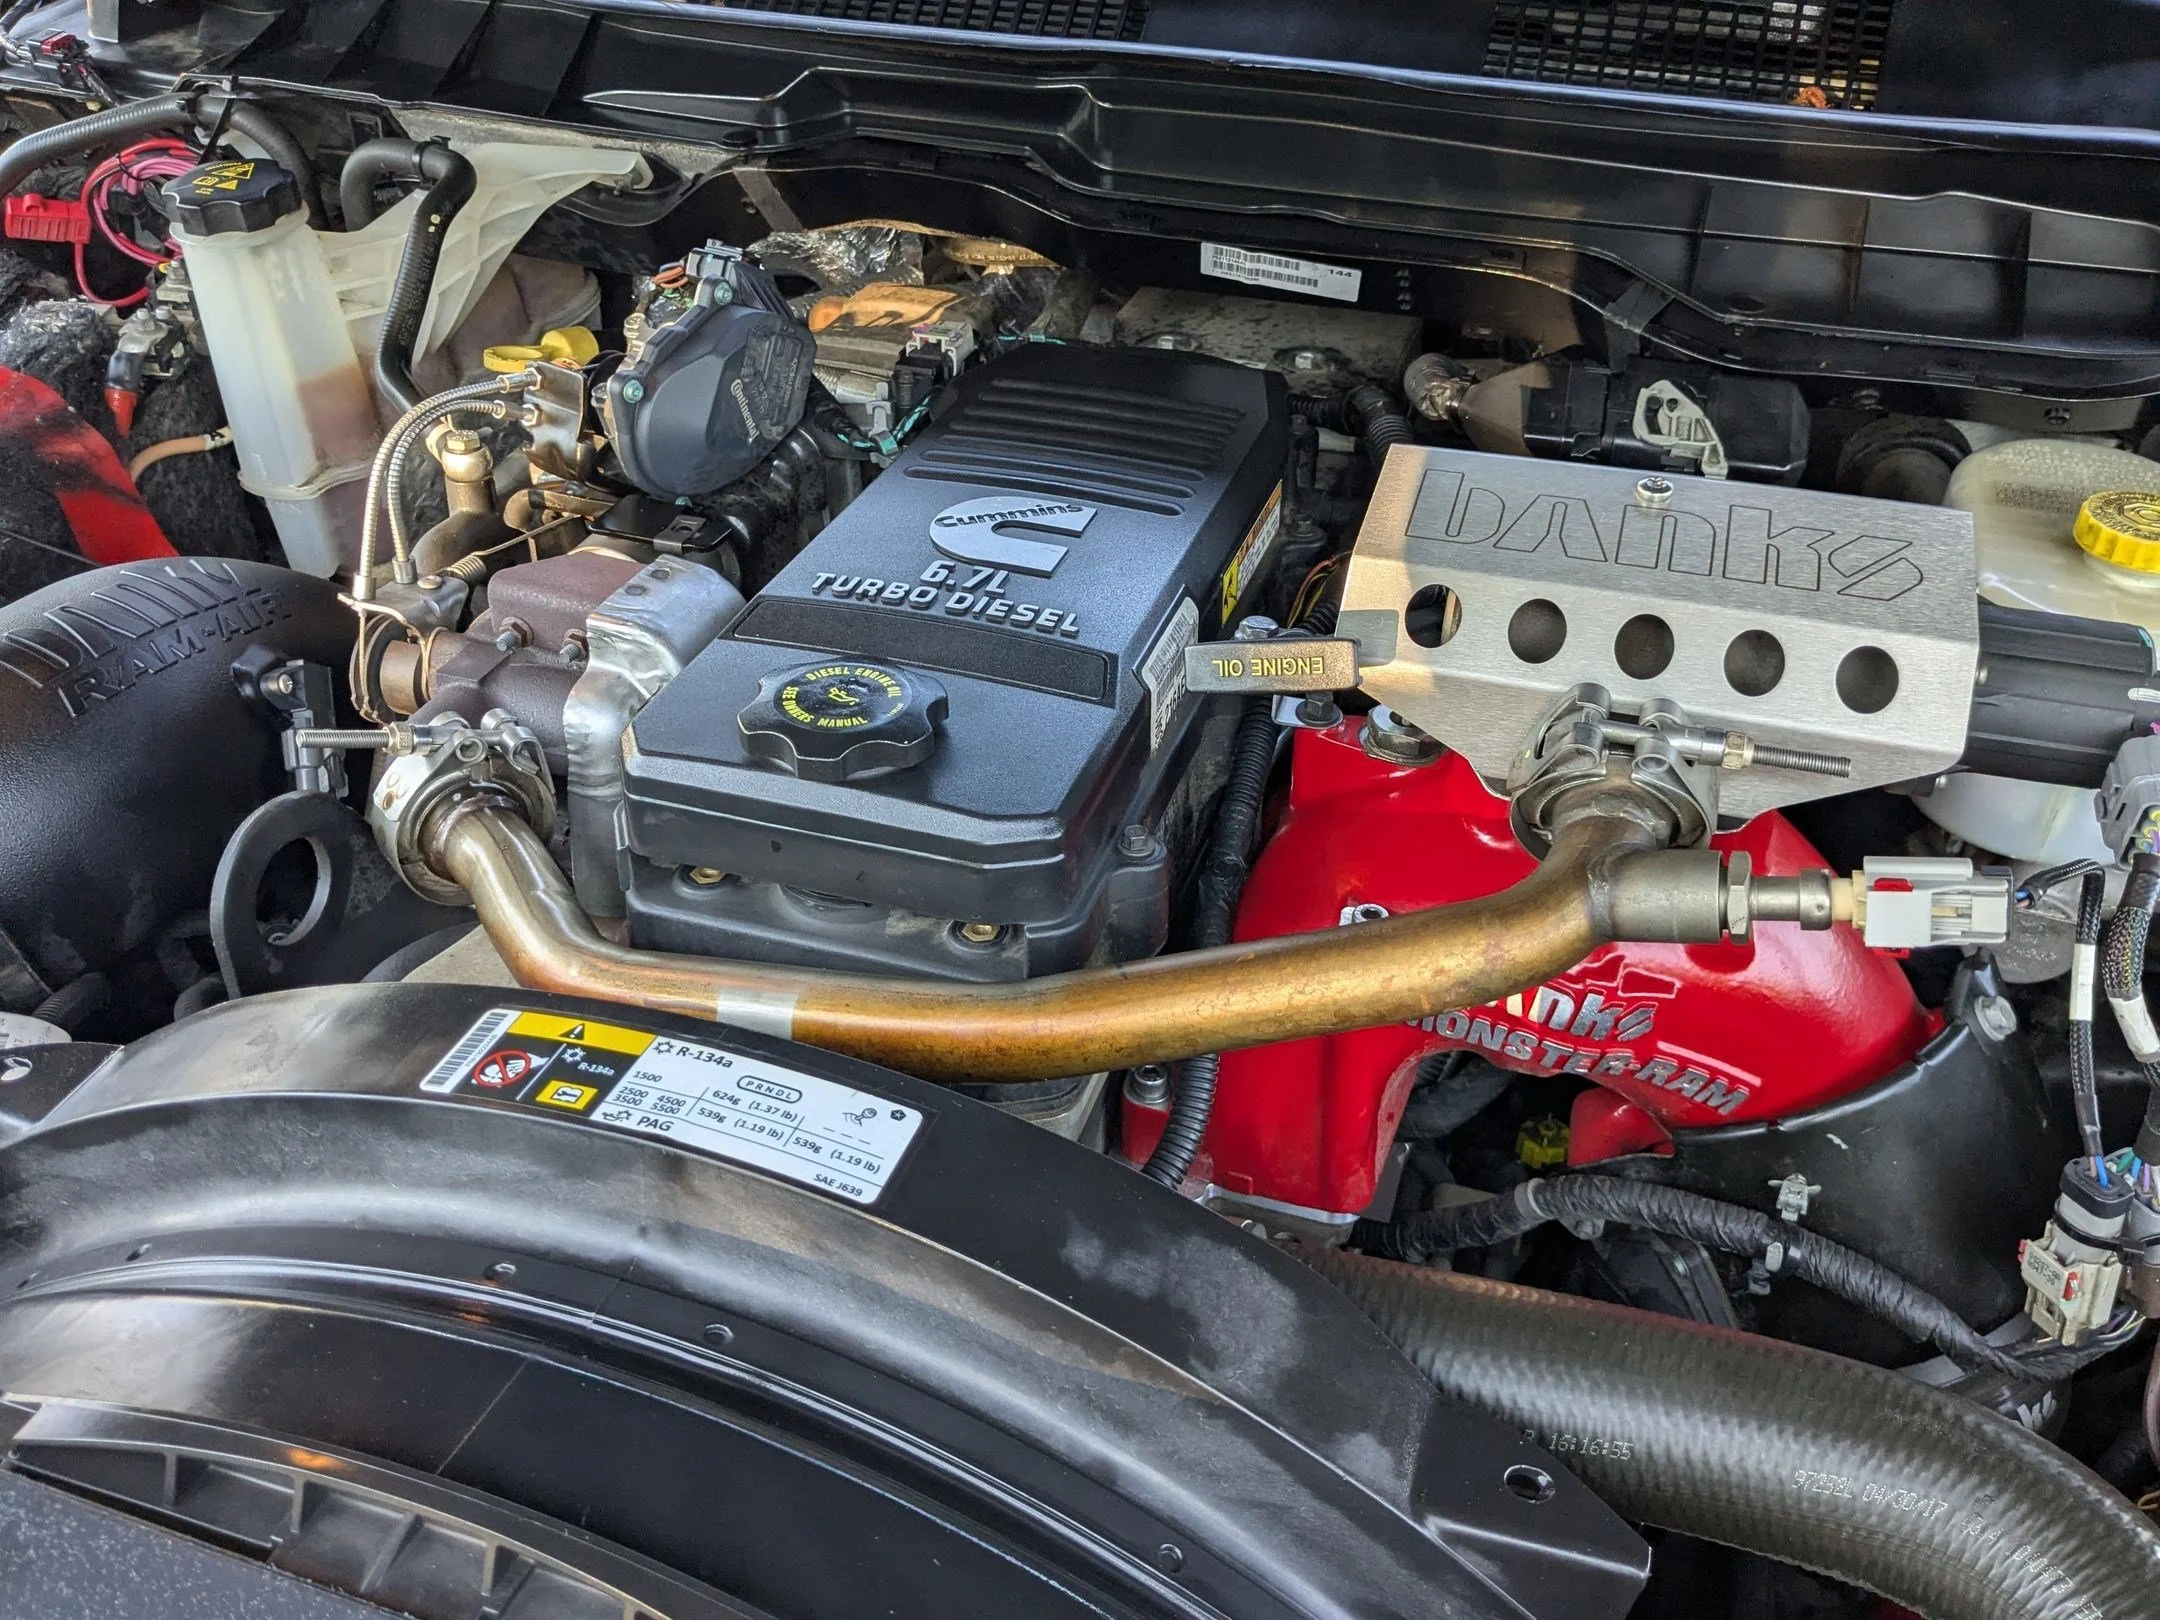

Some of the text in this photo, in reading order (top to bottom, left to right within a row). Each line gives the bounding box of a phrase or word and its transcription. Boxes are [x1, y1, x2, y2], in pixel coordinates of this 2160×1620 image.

[1328, 269, 1353, 278] 144
[731, 378, 760, 443] Continental
[934, 503, 1084, 528] Cummins
[920, 560, 1009, 597] 6.7L
[811, 572, 1080, 637] TURBO DIESEL
[1212, 656, 1325, 677] ENGINE OIL
[805, 666, 902, 698] DIESEL ENGINE OIL
[782, 686, 868, 728] SEE OWNERS MANUAL
[577, 1061, 615, 1077] R-134a
[676, 1046, 733, 1068] R-134a
[633, 1070, 662, 1083] 1500
[613, 1093, 681, 1115] 3500 5500
[619, 1086, 686, 1108] 2500 4500
[712, 1090, 798, 1122] 624g (1.37 lb)
[637, 1115, 674, 1132] PAG
[698, 1107, 784, 1141] 539g (1.19 lb)
[793, 1137, 881, 1175] 539g (1.19 lb)
[813, 1173, 863, 1197] SAE J639
[1549, 1432, 1634, 1460] 16:16:55
[1862, 1483, 1948, 1519] 04/30/17
